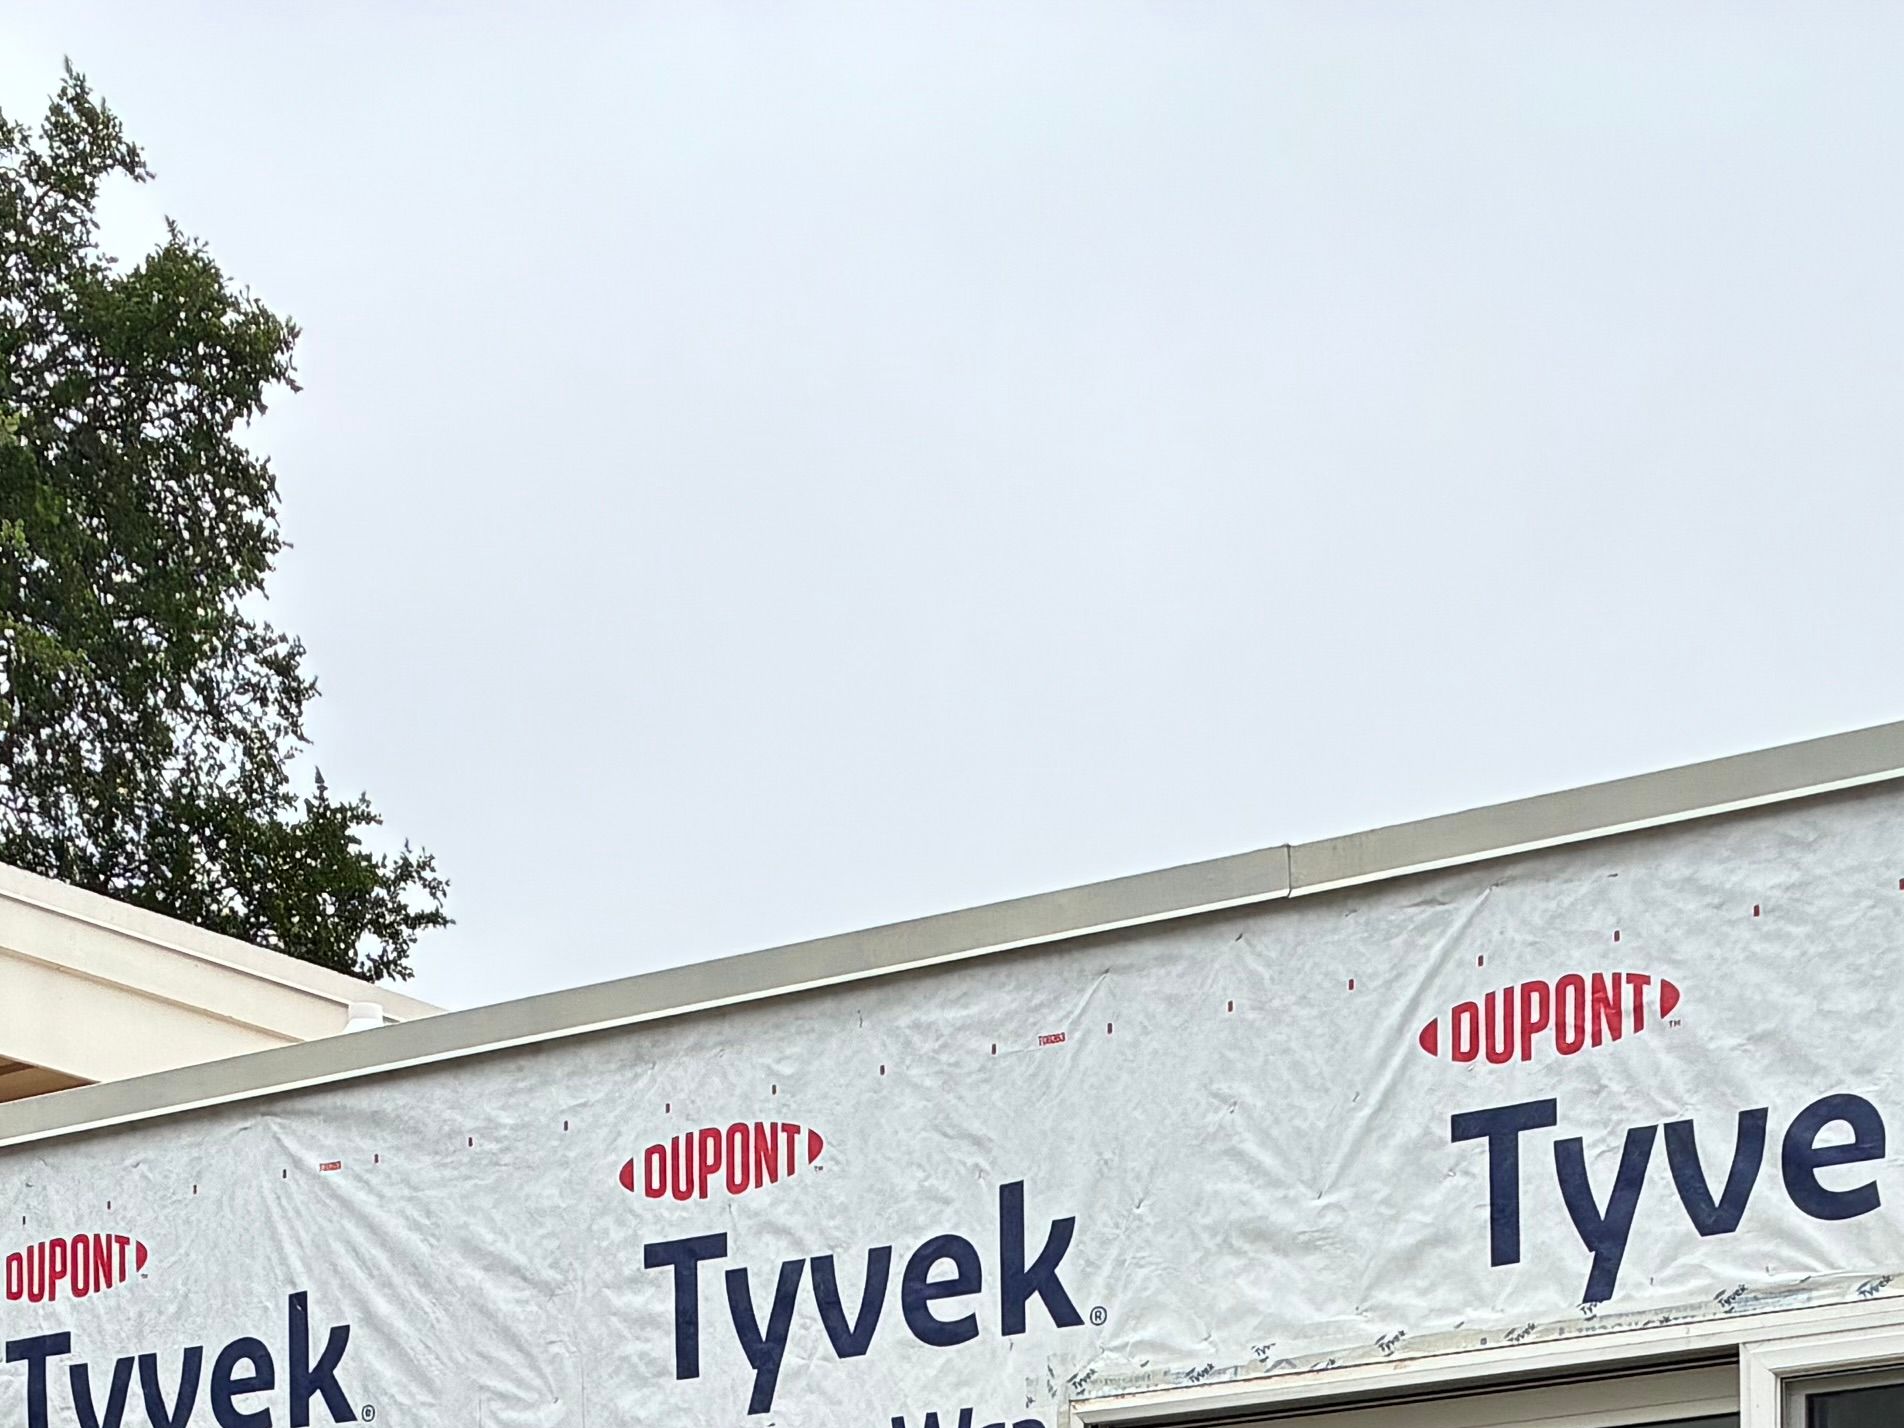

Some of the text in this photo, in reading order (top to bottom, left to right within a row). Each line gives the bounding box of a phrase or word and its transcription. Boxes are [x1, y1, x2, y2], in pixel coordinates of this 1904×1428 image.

[1451, 972, 1650, 1063] DUPONT
[644, 1121, 800, 1200] DUPONT
[6, 1233, 131, 1301] DUPONT
[643, 1180, 1085, 1414] Tyvek
